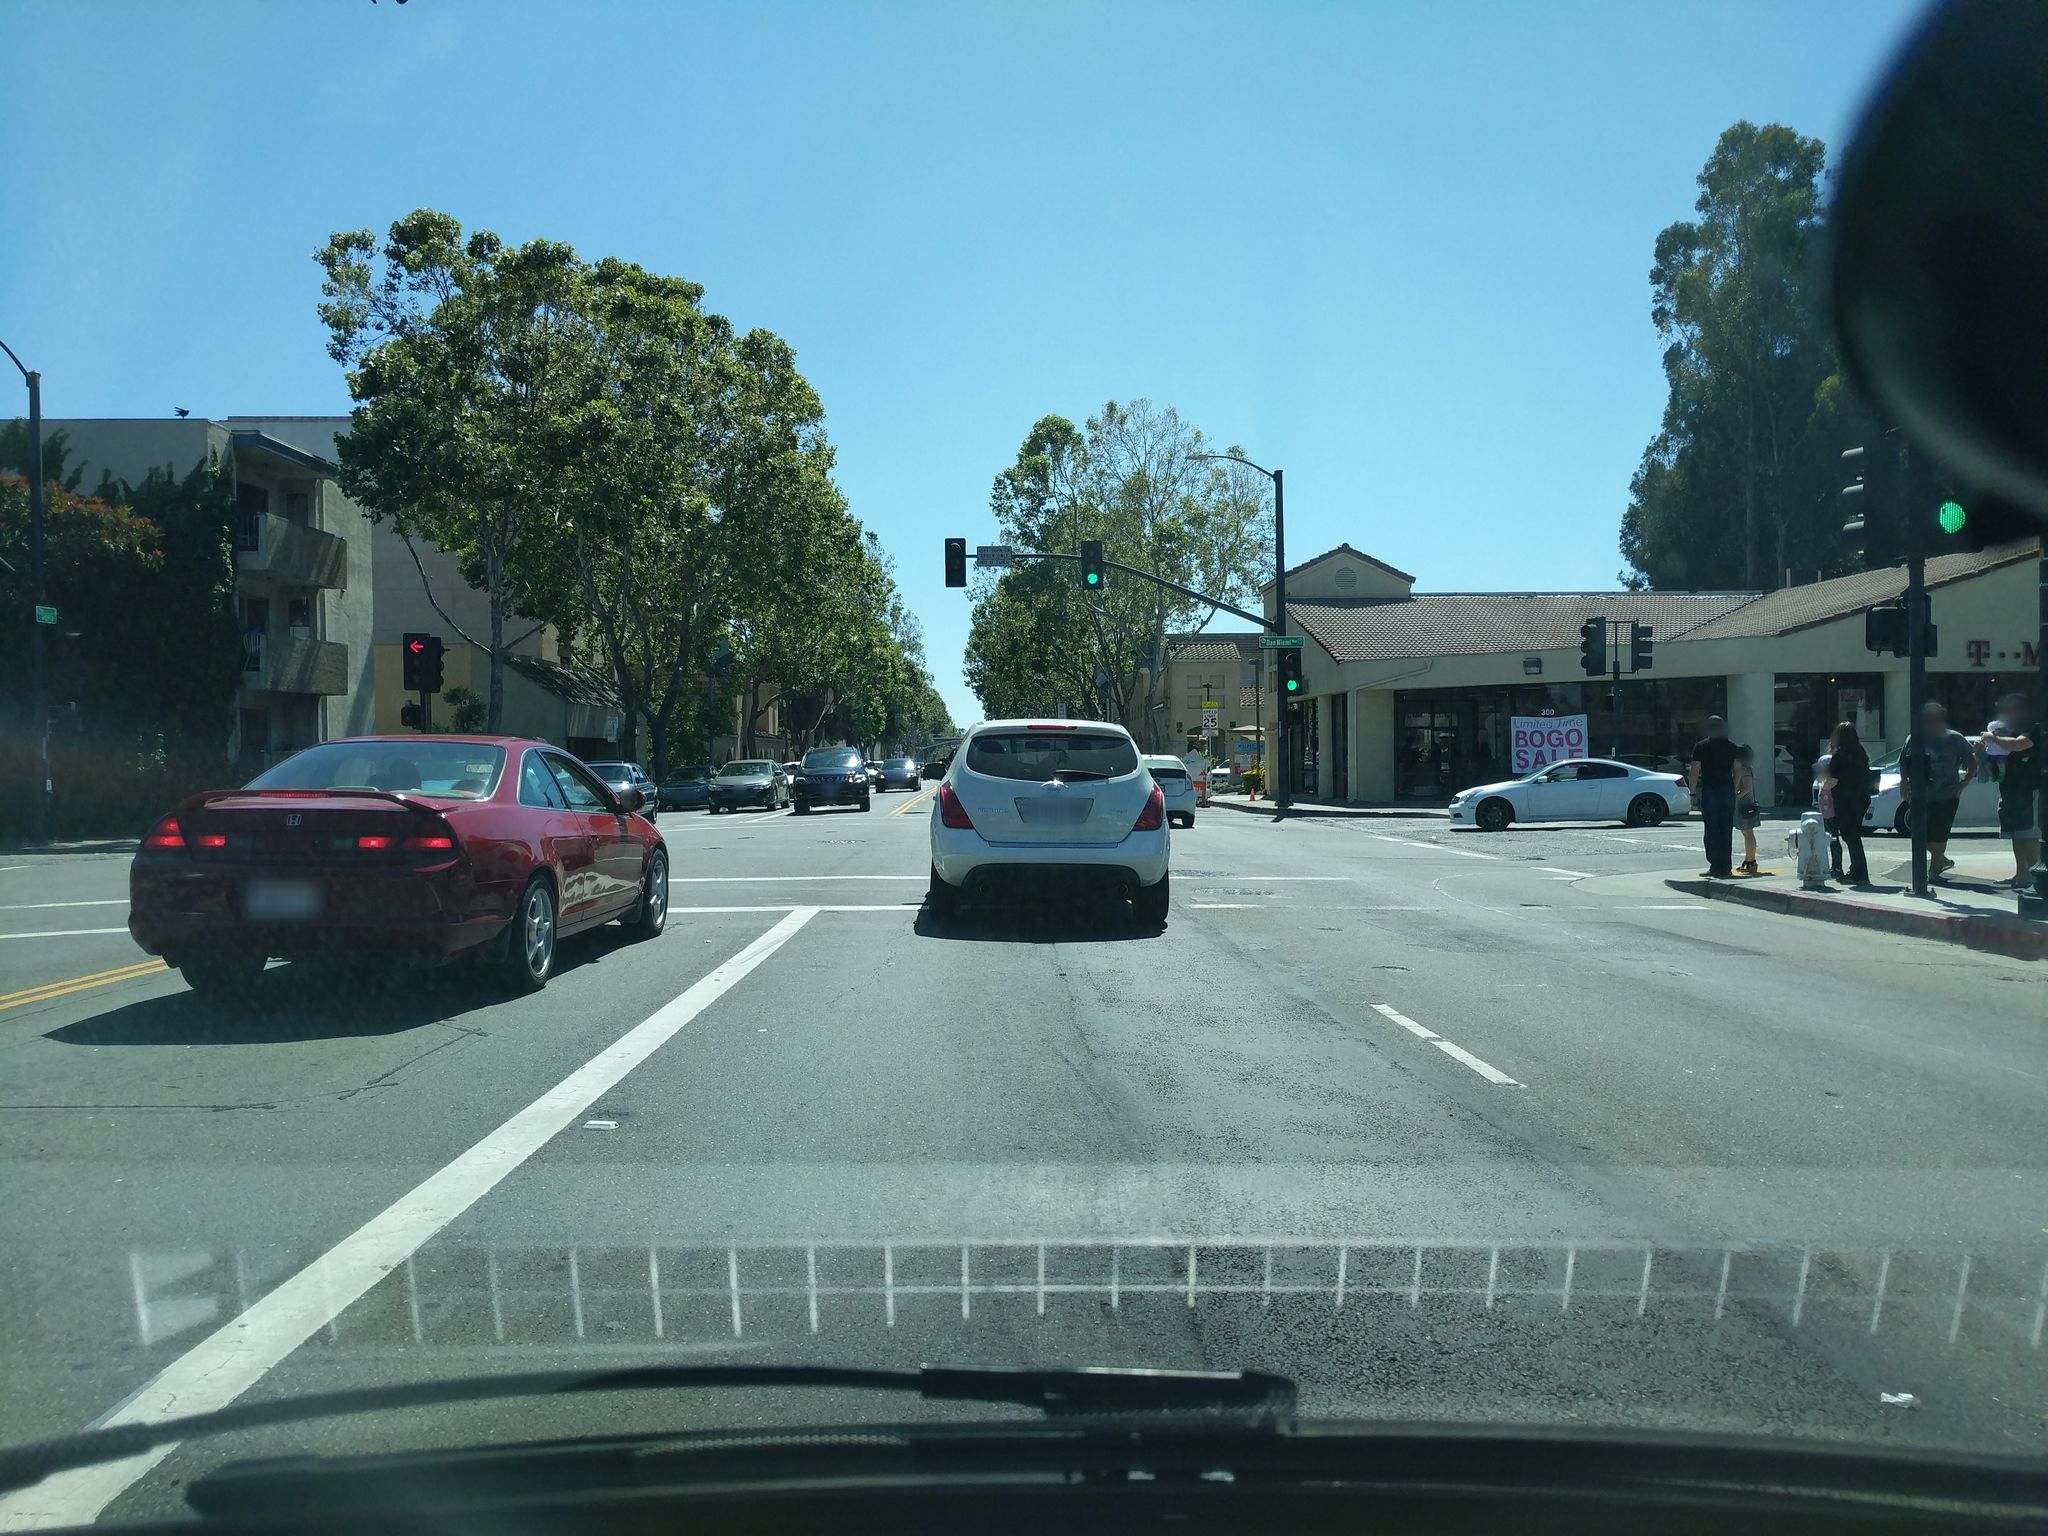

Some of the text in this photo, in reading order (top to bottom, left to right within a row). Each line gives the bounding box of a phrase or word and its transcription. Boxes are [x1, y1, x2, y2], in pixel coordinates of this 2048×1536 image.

[1203, 718, 1217, 727] 25
[1514, 718, 1583, 729] Limited Time
[1515, 728, 1583, 748] BOGO
